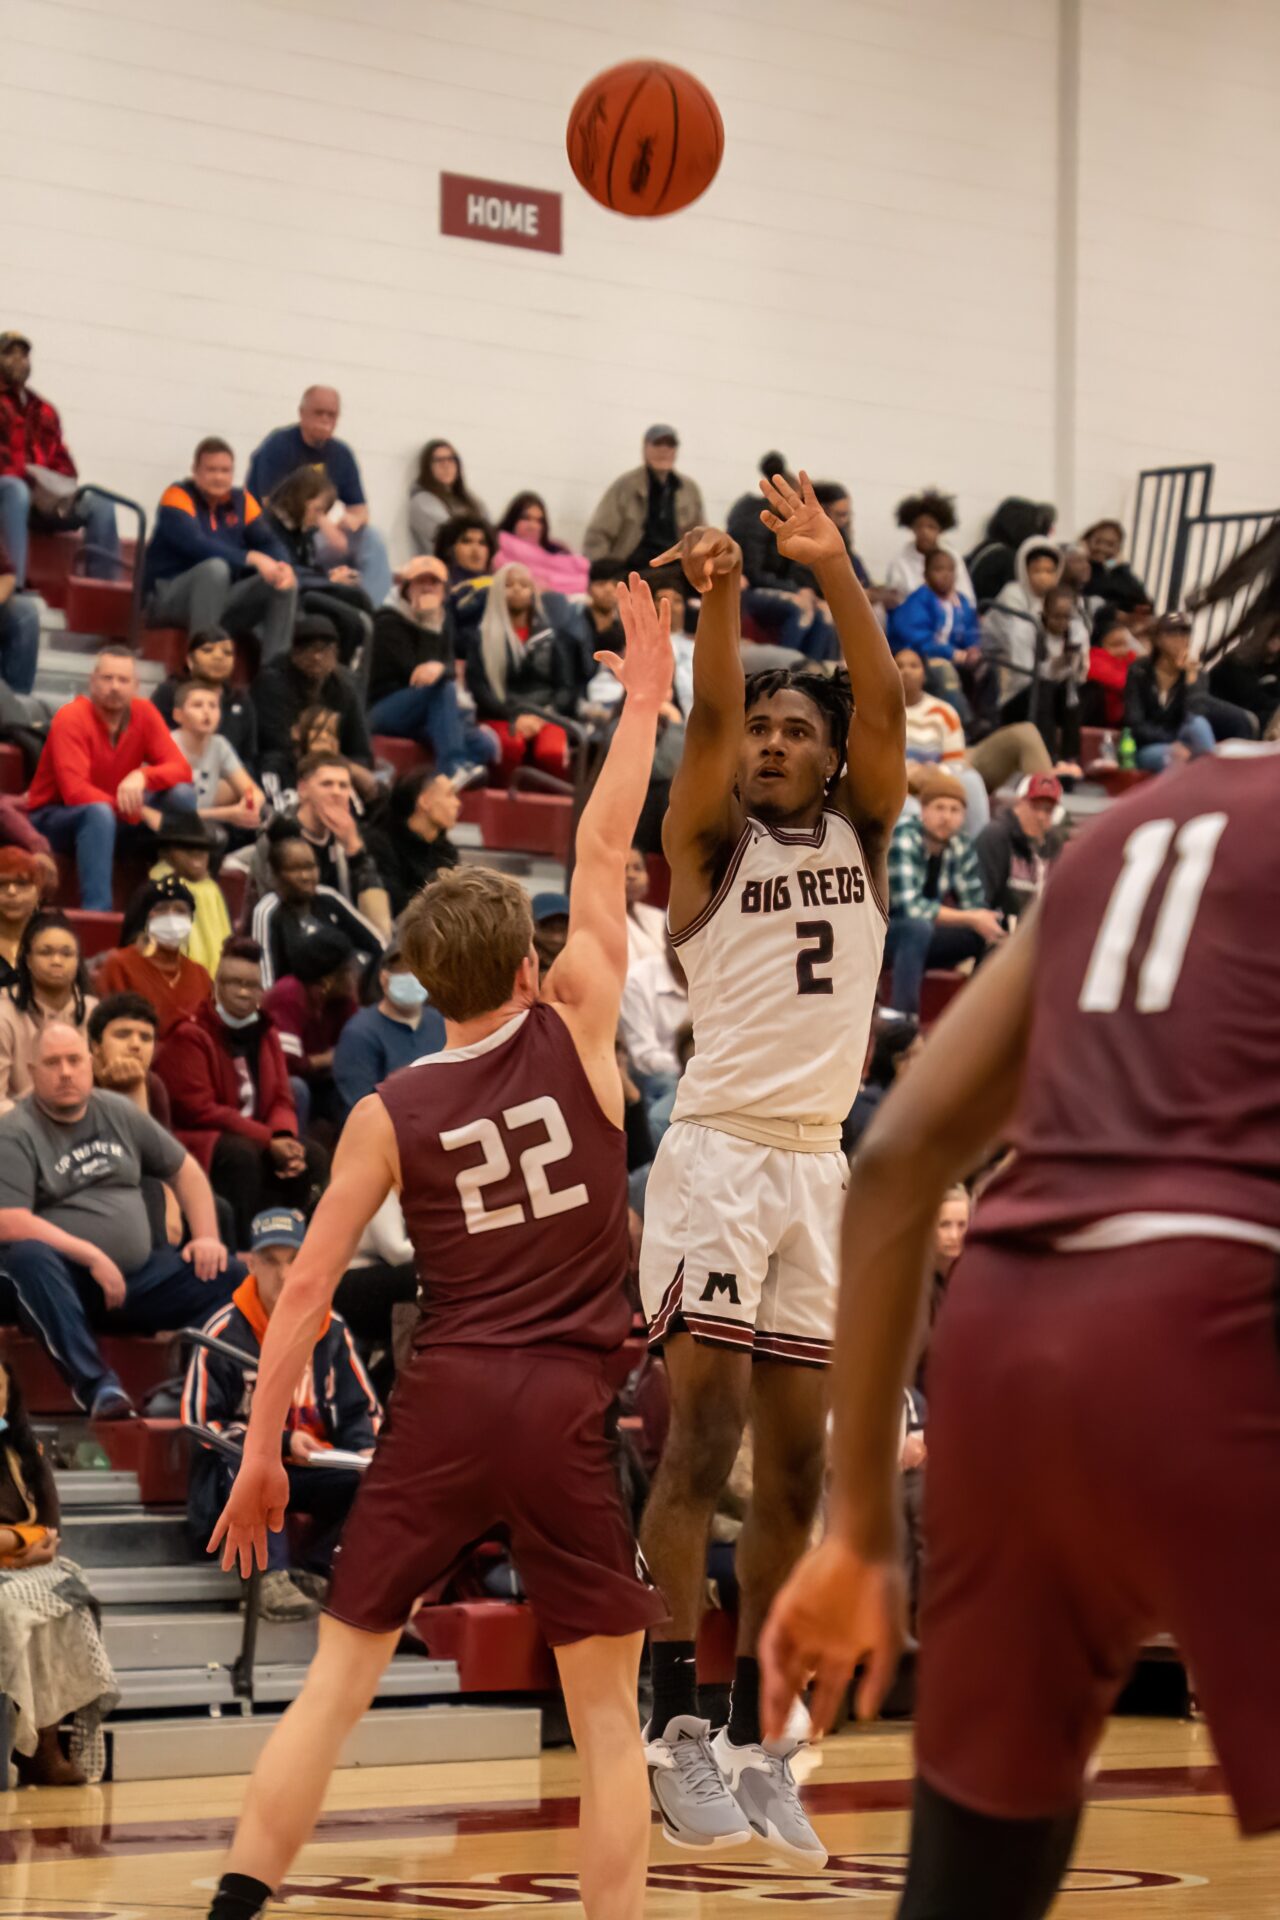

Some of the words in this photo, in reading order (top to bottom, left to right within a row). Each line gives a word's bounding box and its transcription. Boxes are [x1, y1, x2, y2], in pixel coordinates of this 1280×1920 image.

[467, 193, 539, 237] HOME
[741, 875, 792, 914] BIG
[797, 865, 865, 907] REDS
[1078, 811, 1228, 1013] 11
[795, 919, 834, 995] 2
[439, 1095, 590, 1234] 22
[699, 1271, 741, 1305] M
